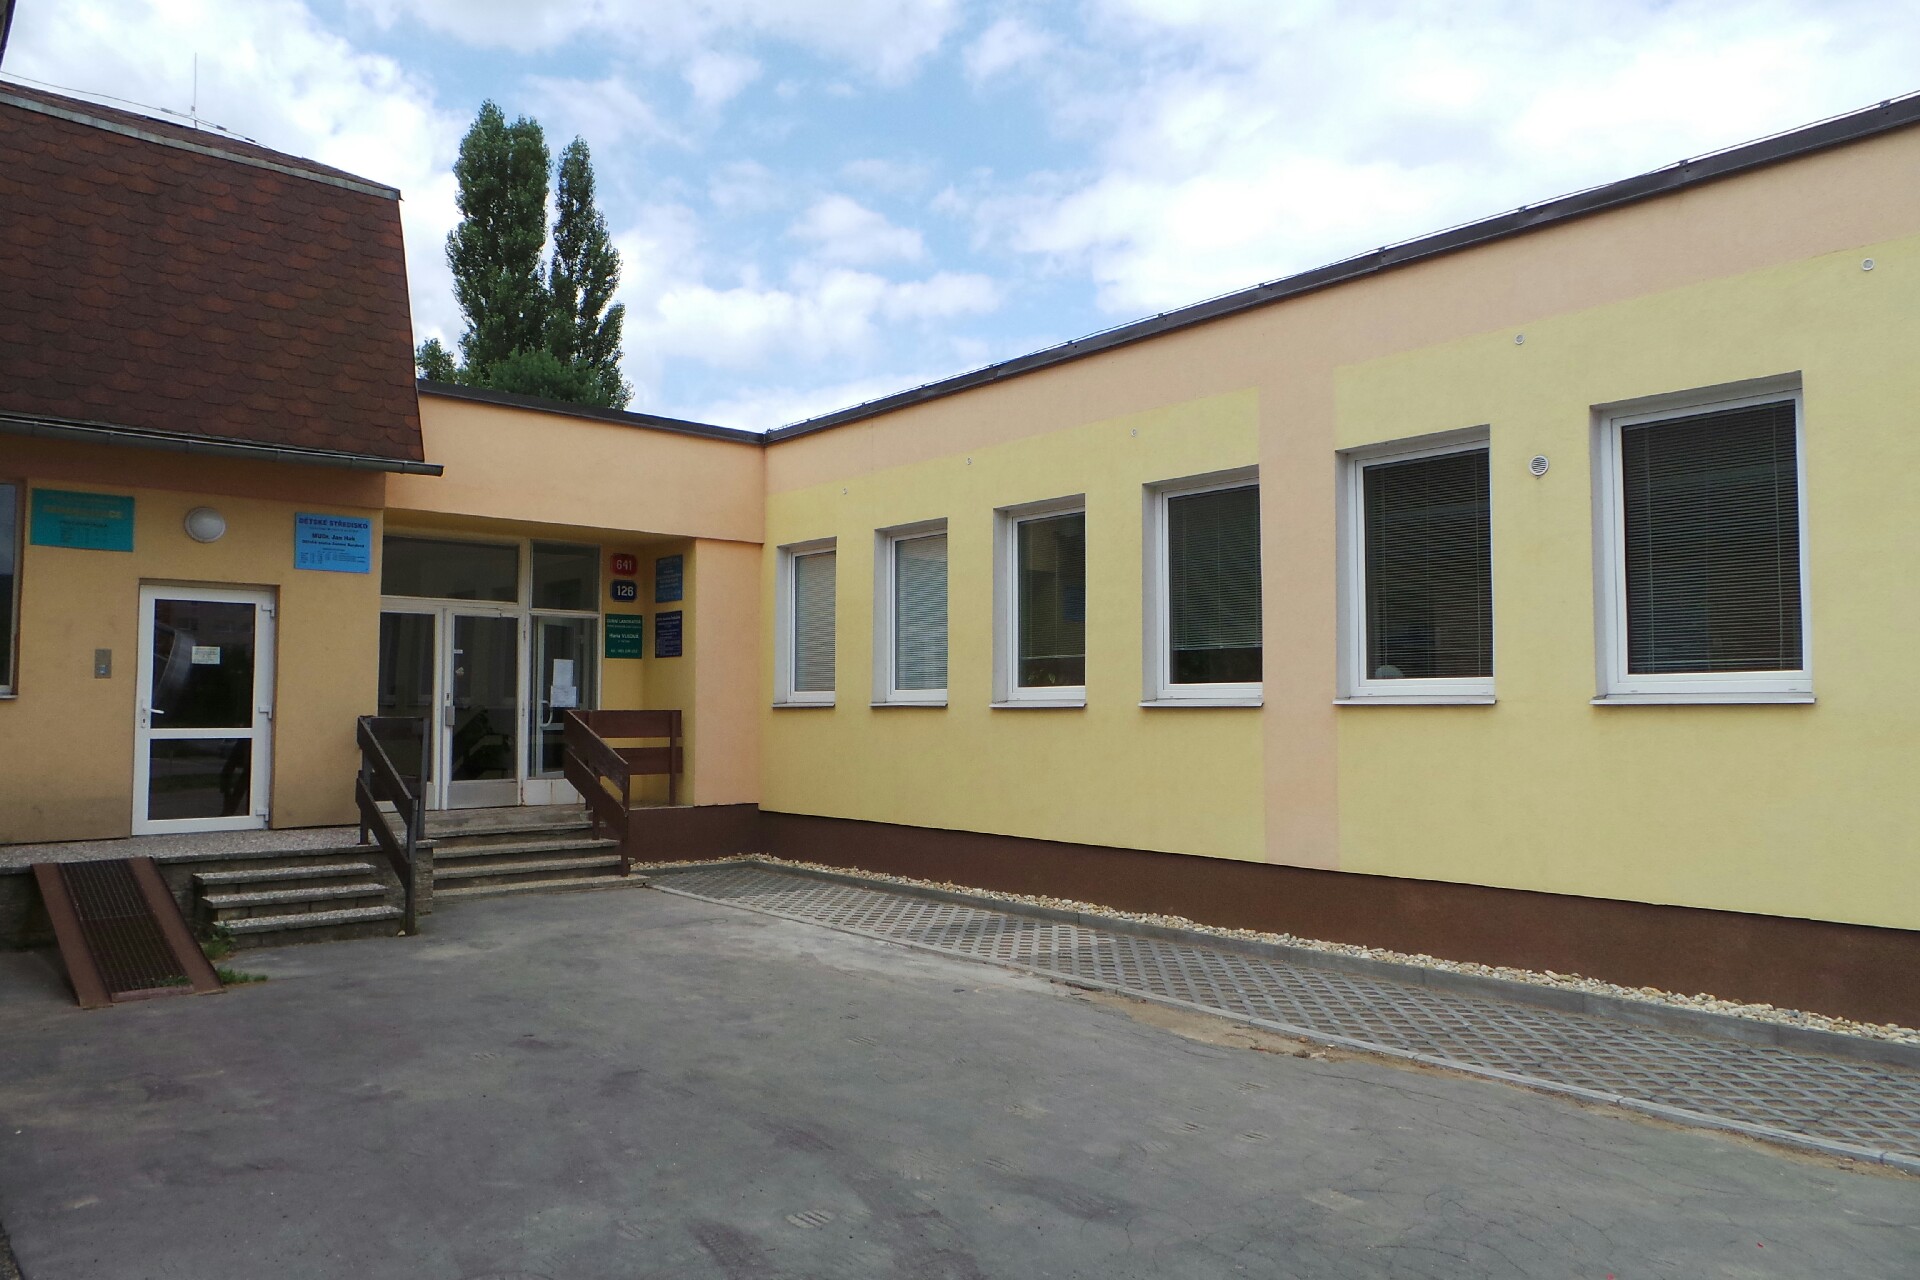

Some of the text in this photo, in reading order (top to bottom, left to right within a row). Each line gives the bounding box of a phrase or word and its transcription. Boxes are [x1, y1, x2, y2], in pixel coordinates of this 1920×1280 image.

[330, 520, 368, 529] STŘEDISKO
[616, 559, 632, 571] 641
[617, 585, 634, 597] 126
